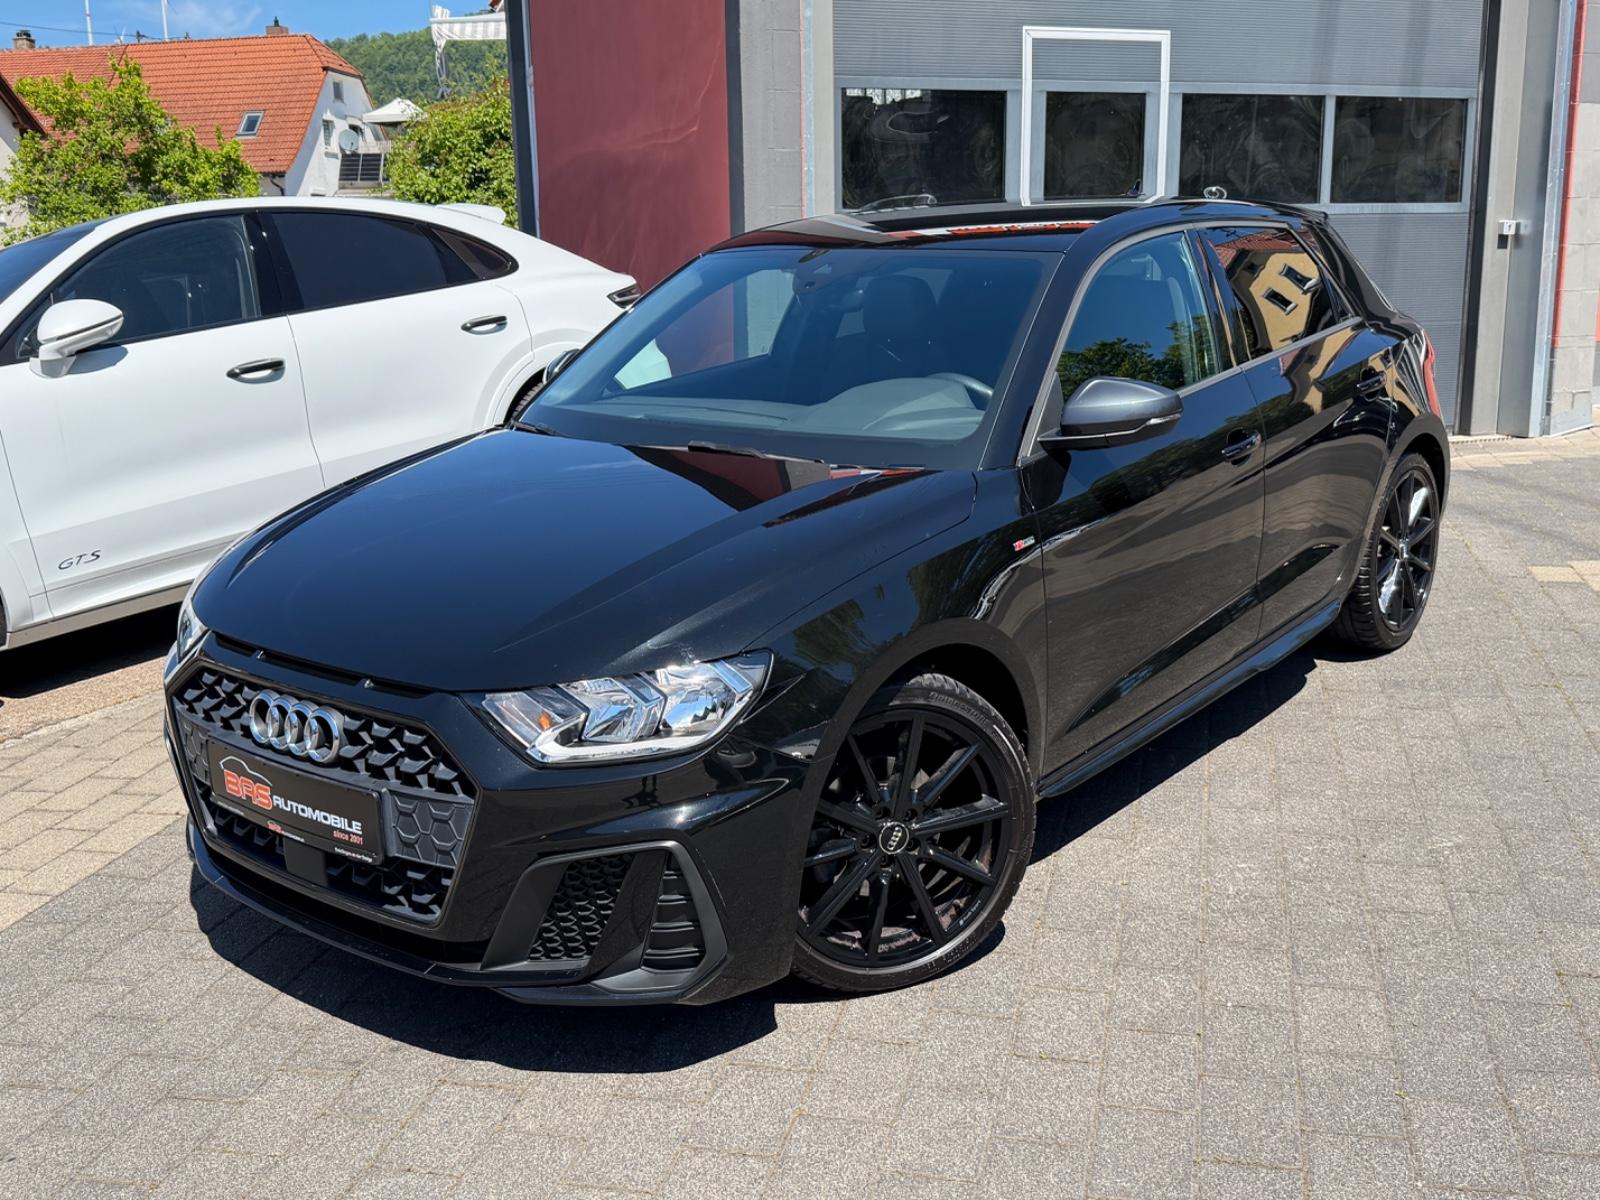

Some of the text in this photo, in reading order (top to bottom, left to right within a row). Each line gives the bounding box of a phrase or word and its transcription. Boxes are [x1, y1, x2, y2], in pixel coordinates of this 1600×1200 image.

[58, 549, 101, 570] GTS
[223, 769, 273, 811] BAS
[272, 795, 363, 835] AUTOMOBILE
[333, 830, 364, 846] since 2001
